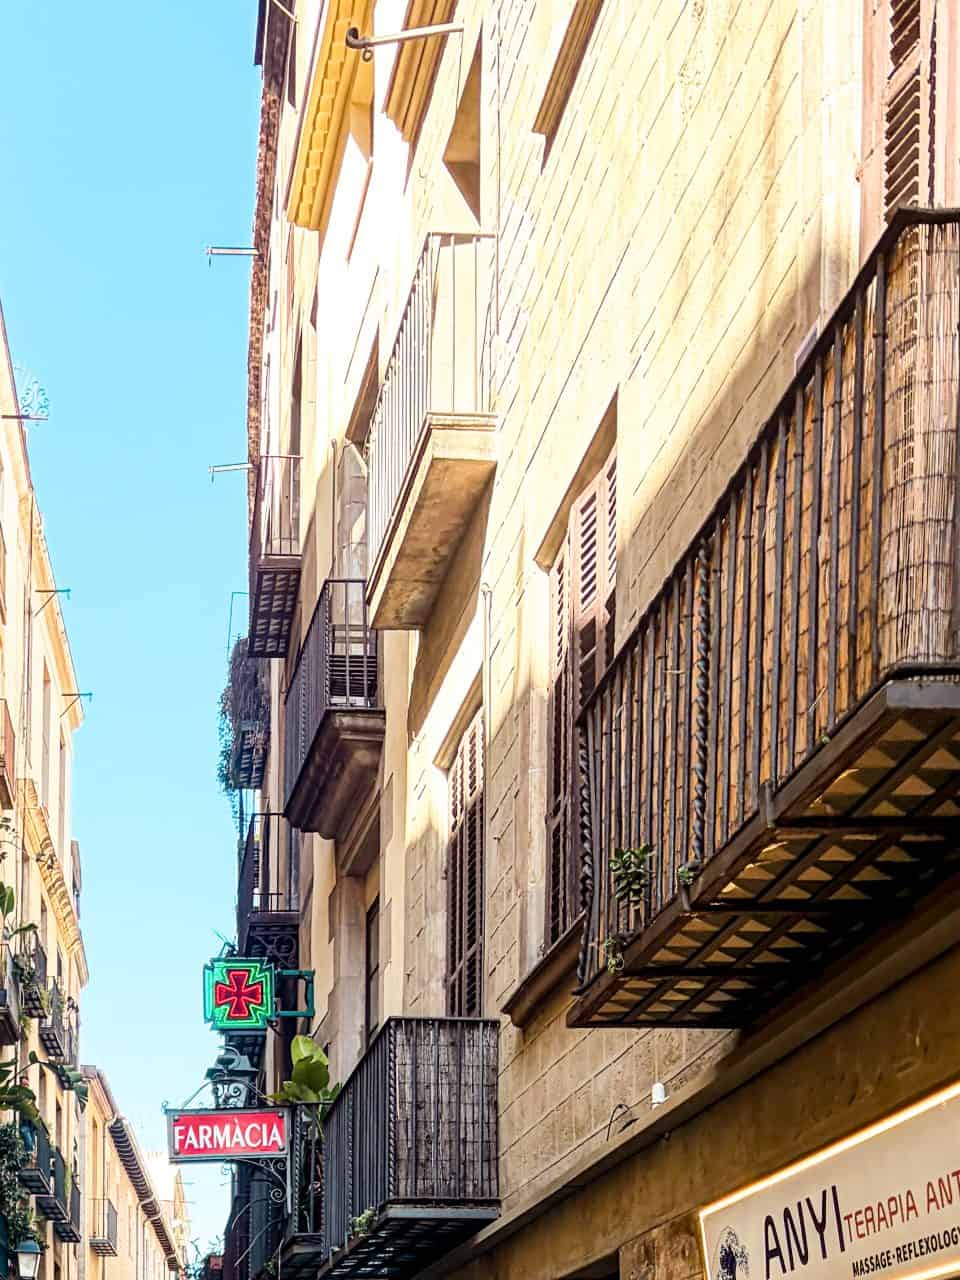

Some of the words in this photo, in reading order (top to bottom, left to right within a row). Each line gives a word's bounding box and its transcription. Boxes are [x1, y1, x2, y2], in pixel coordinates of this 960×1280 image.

[174, 1118, 283, 1150] FARMÀCIA
[763, 1185, 846, 1280] ANYI
[843, 1190, 919, 1242] TERAPIA
